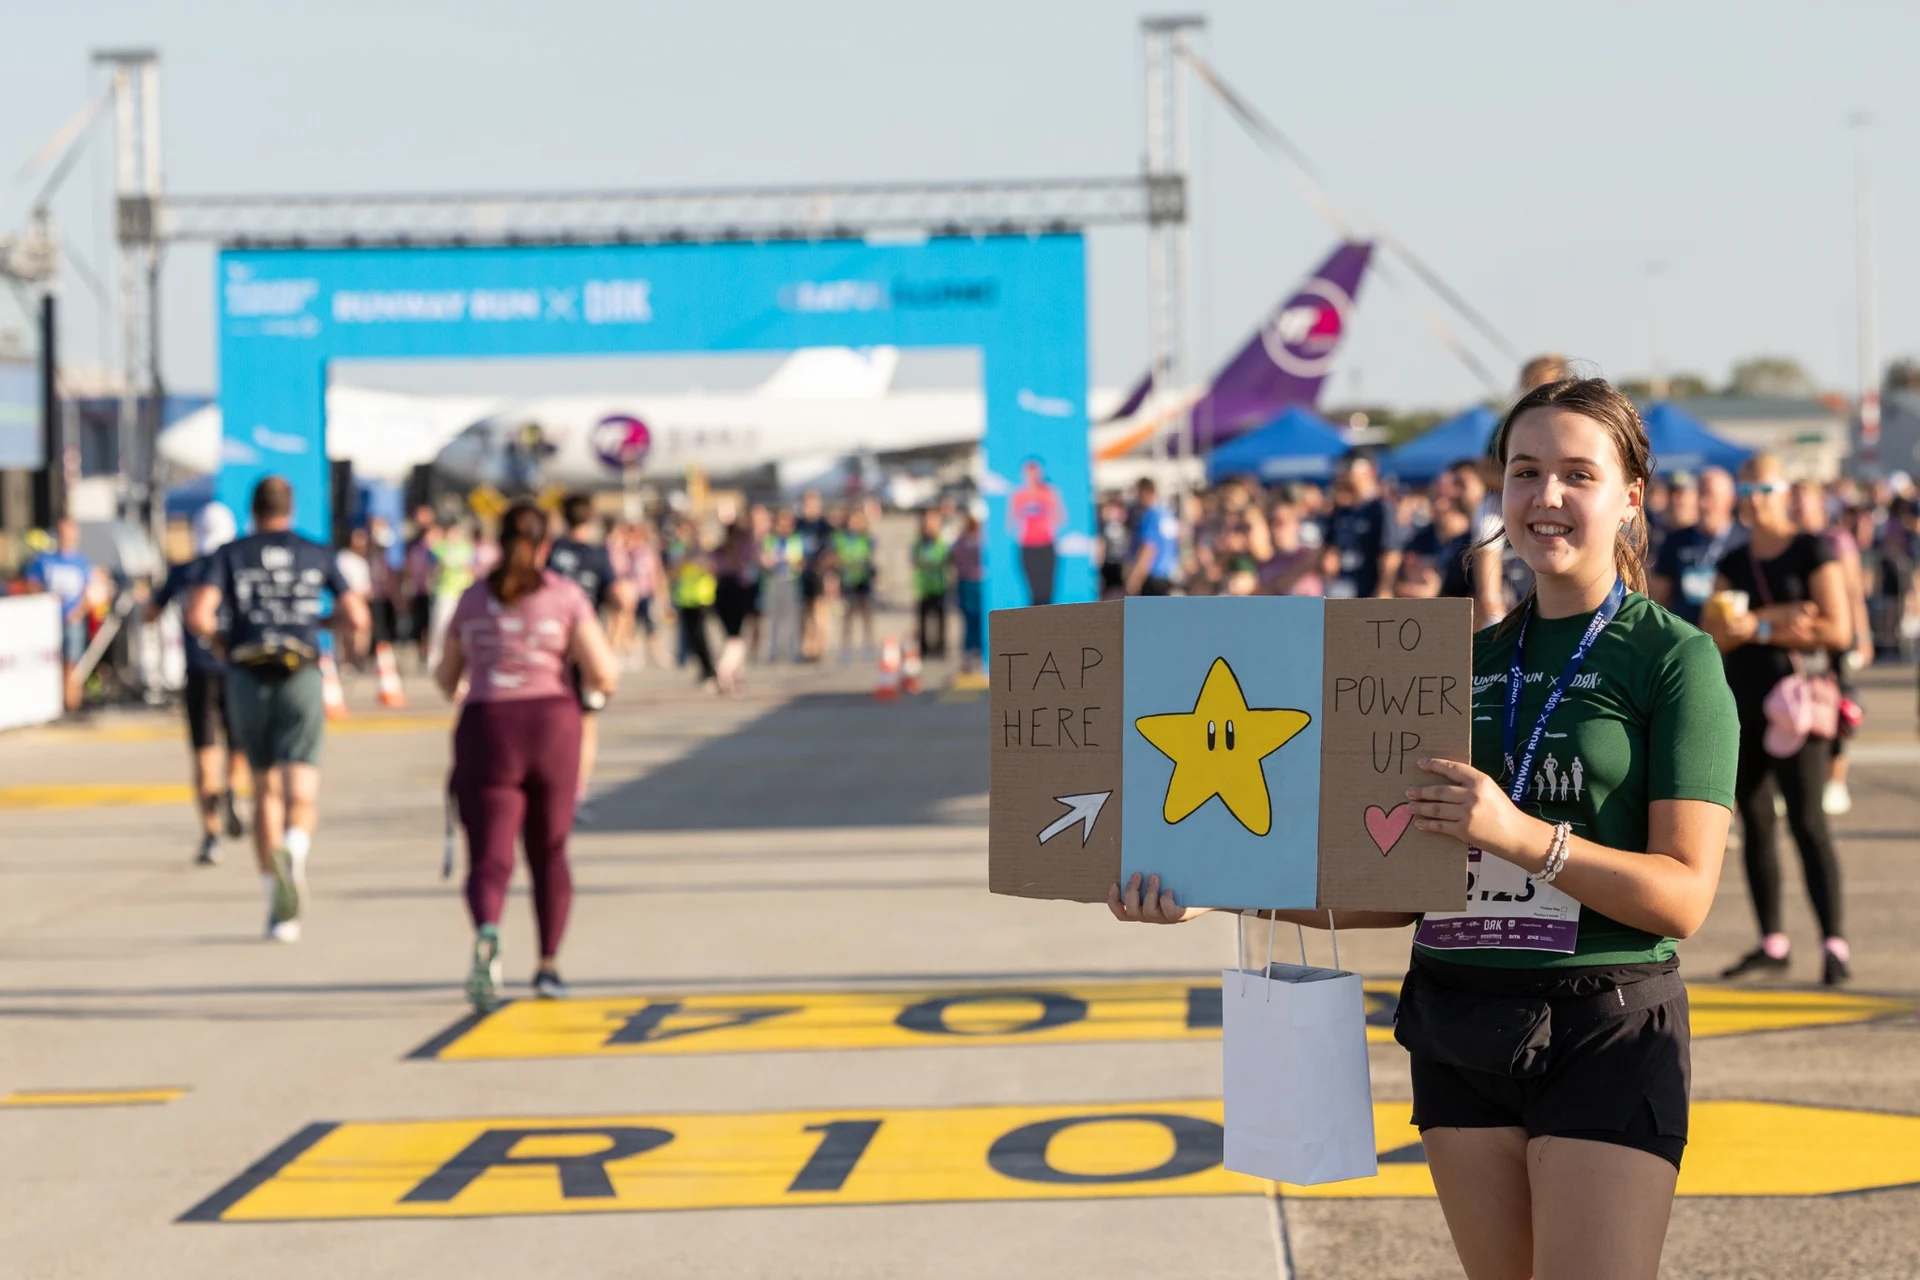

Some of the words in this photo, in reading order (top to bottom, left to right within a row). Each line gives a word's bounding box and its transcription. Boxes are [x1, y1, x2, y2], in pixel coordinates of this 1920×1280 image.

[1365, 618, 1422, 651] TO
[1580, 611, 1605, 647] BUDAPEST
[1587, 618, 1608, 648] AIRPORT
[999, 647, 1104, 692] TAP
[1472, 672, 1508, 687] UNWA
[1335, 675, 1463, 716] POWER
[1510, 678, 1519, 705] VINCI
[1003, 706, 1102, 748] HERE
[1371, 731, 1421, 775] UP
[1511, 752, 1533, 802] RUNWAY
[1528, 726, 1542, 750] RUN
